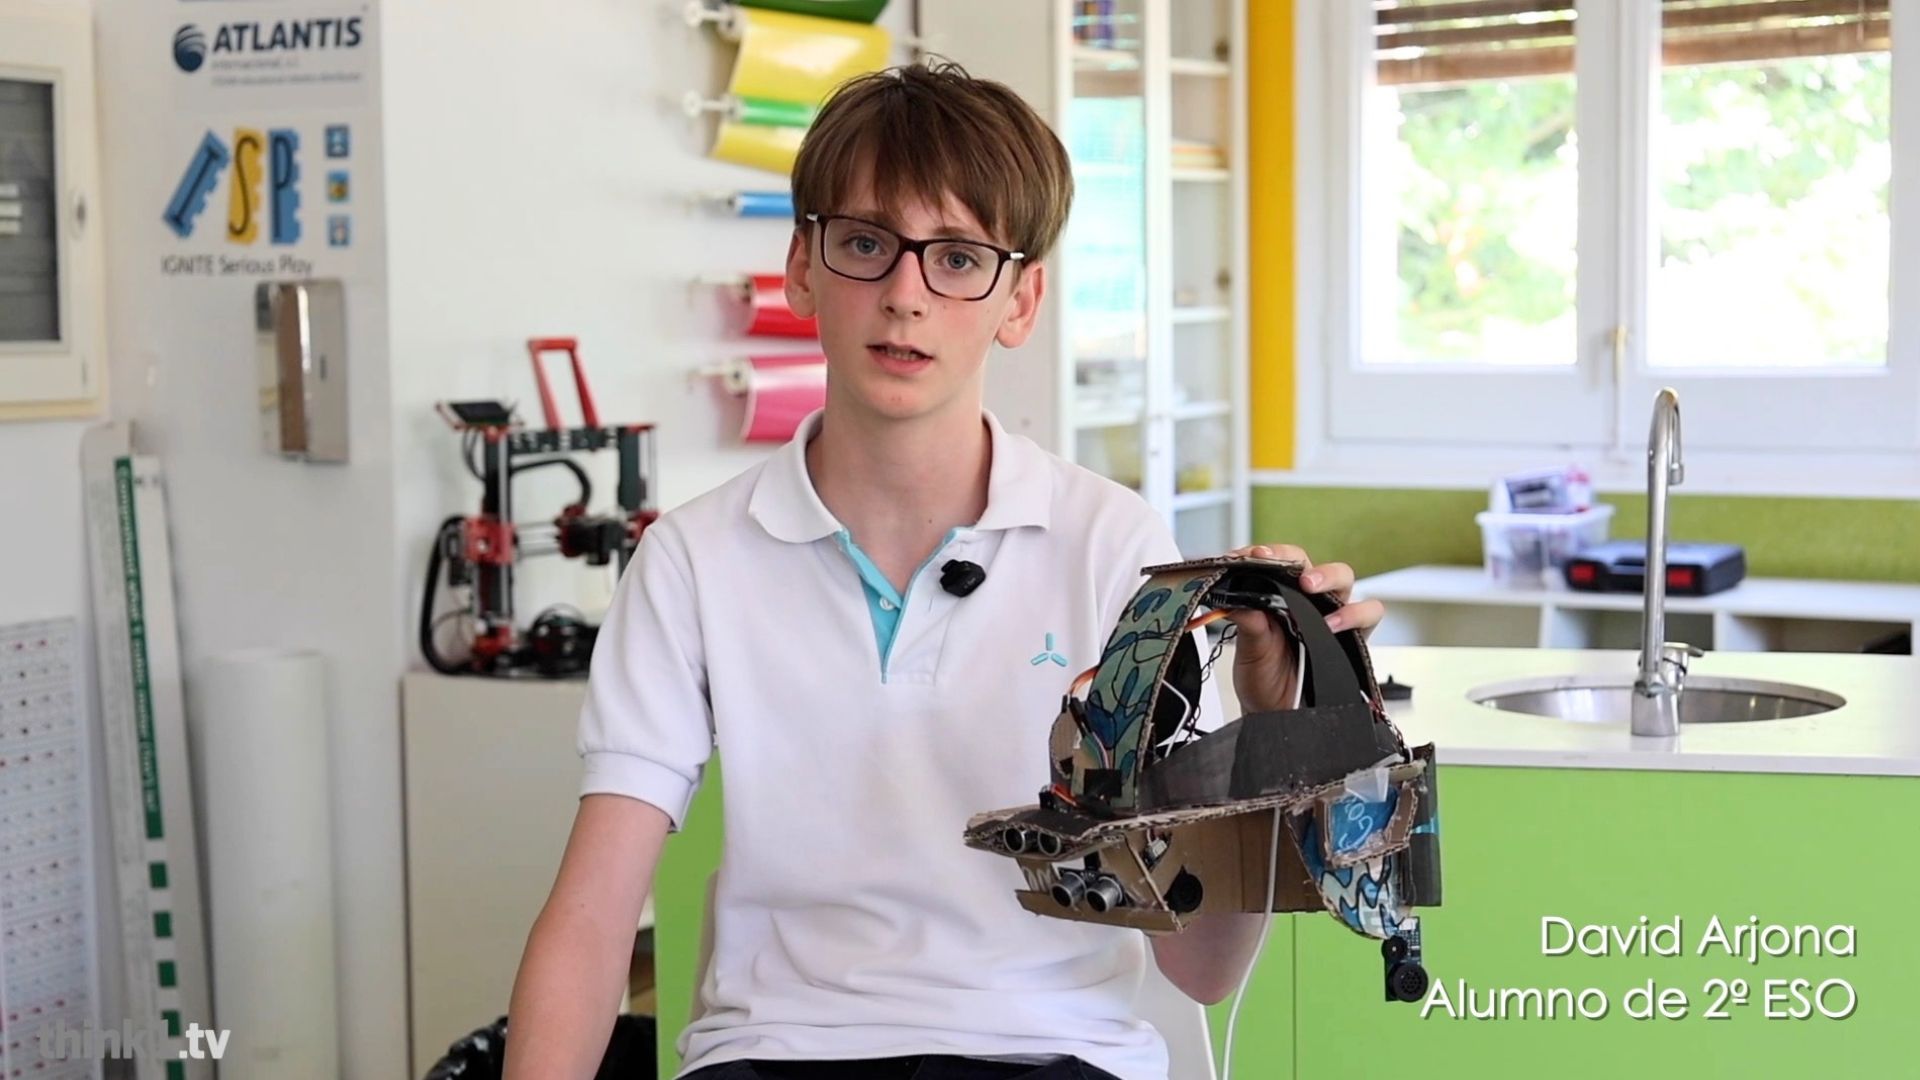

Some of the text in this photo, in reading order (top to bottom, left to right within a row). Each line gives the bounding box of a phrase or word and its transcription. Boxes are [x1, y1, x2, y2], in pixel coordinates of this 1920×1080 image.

[213, 17, 362, 53] ATLANTIS
[161, 253, 314, 276] IGNITE Serious Play
